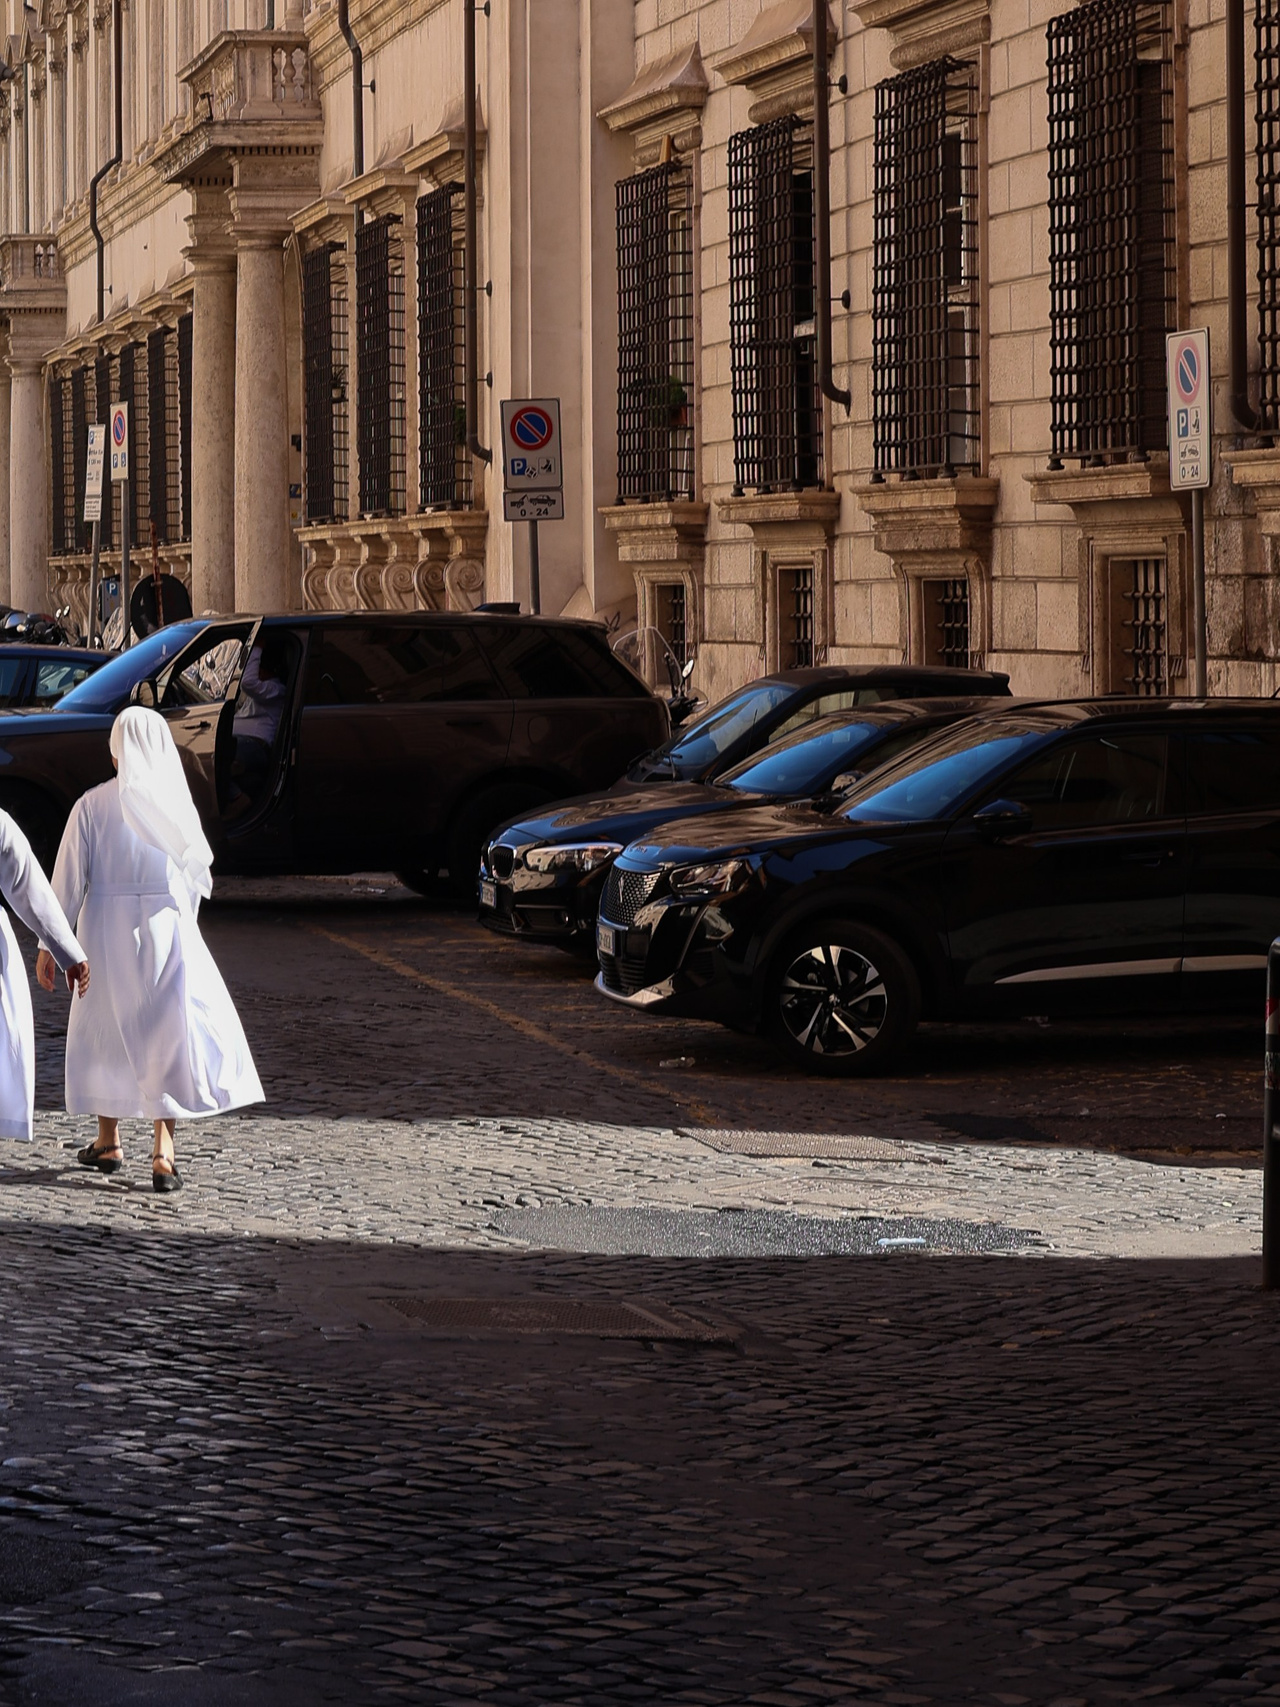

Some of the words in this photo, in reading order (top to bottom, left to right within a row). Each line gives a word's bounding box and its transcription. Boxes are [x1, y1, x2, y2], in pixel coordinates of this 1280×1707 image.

[1179, 413, 1186, 434] P
[514, 460, 523, 474] P
[1181, 468, 1186, 478] 0
[1190, 465, 1199, 478] 24
[520, 508, 527, 517] 0
[536, 507, 549, 517] 24
[109, 583, 116, 595] P
